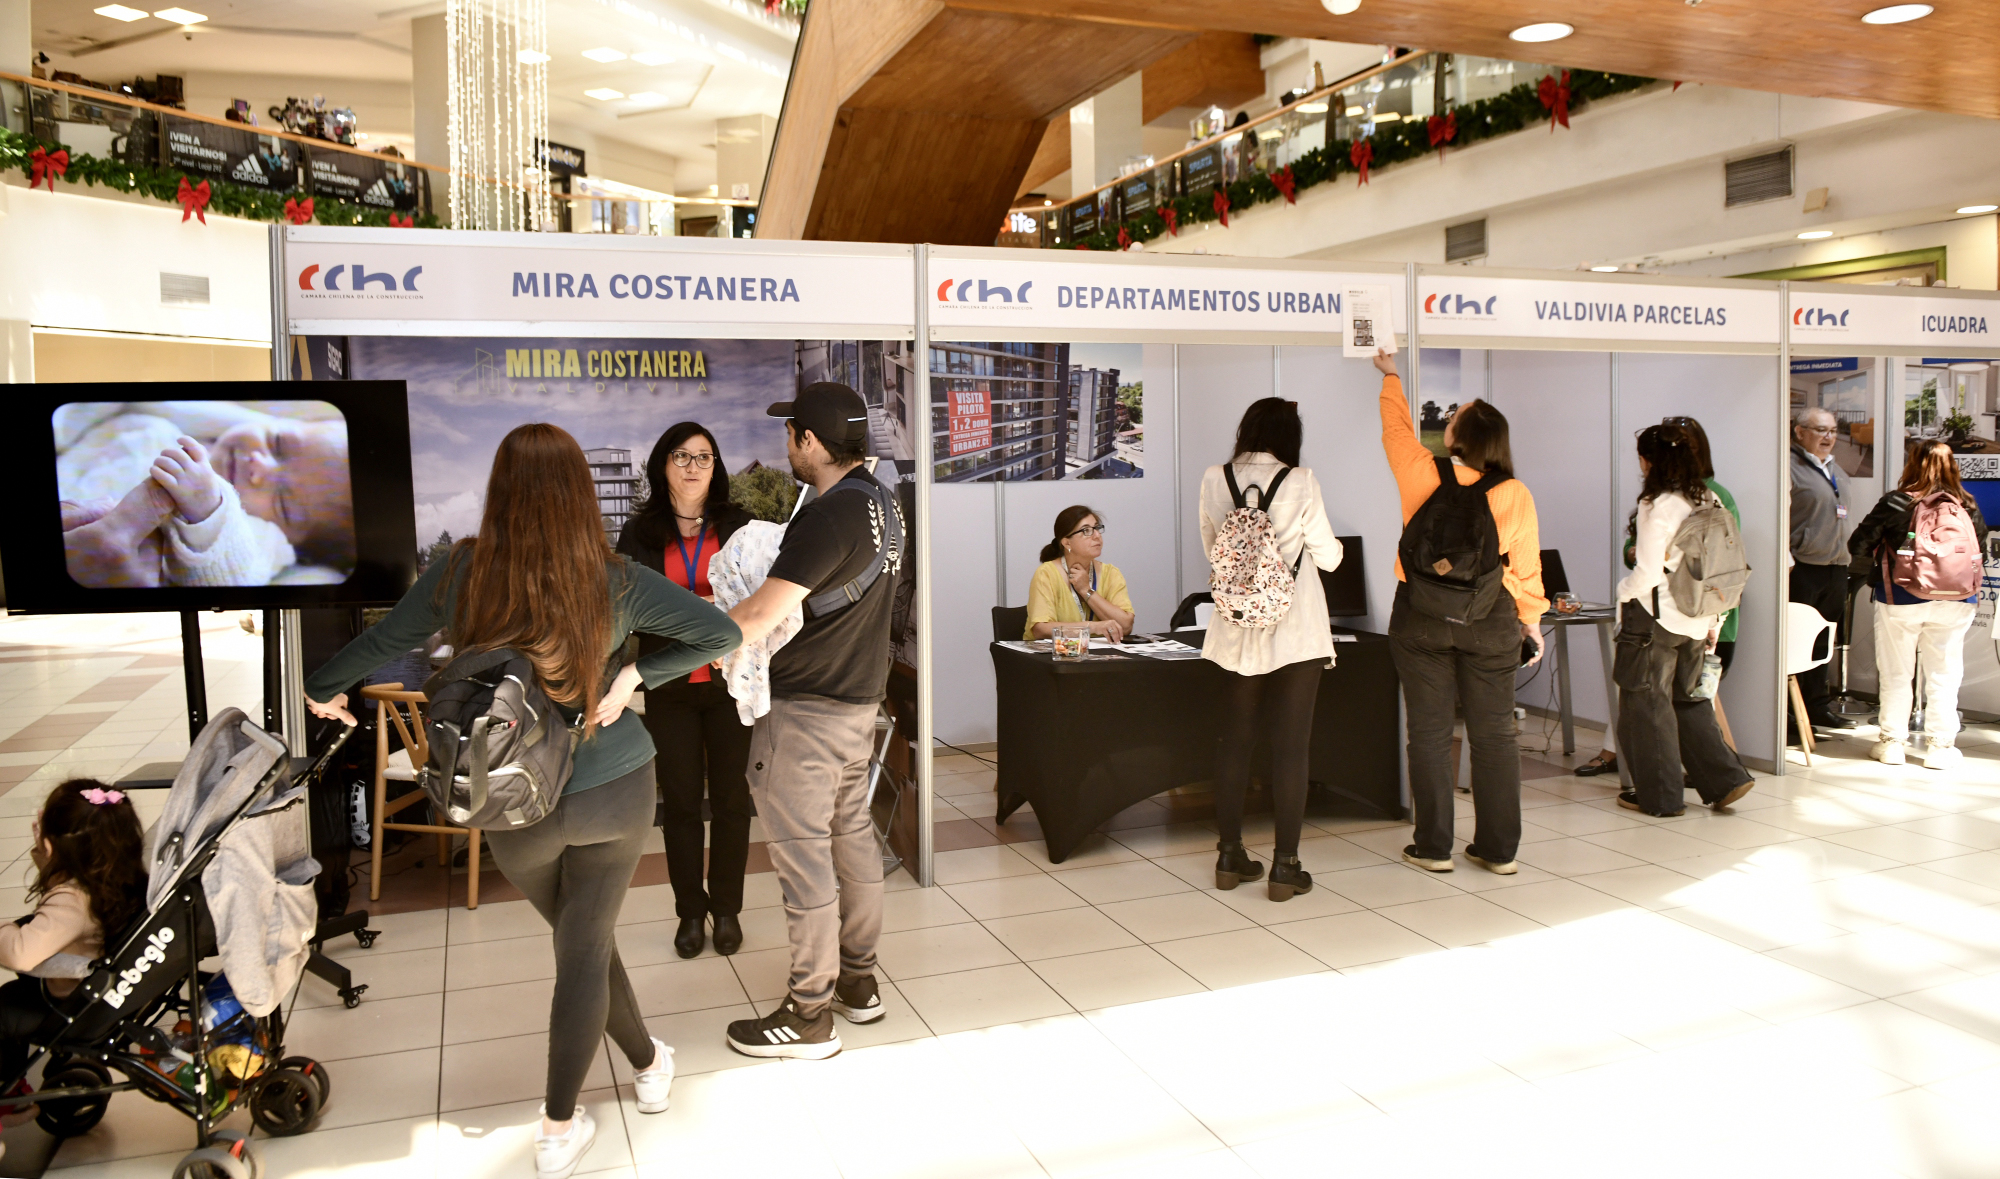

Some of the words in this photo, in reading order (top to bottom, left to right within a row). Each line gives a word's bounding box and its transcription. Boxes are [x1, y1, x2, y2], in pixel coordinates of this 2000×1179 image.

[193, 136, 200, 146] A
[232, 169, 268, 185] adidas
[512, 272, 599, 298] MIRA
[609, 274, 800, 302] COSTANERA
[1057, 285, 1260, 312] DEPARTAMENTOS
[1535, 300, 1627, 322] VALDIVIA
[1634, 304, 1726, 326] PARCELAS
[1922, 315, 1988, 333] ICUADRA
[506, 348, 581, 378] MIRA
[587, 350, 707, 378] COSTANERA
[508, 382, 708, 394] VALDIVIA
[956, 392, 984, 404] VISITA
[958, 404, 984, 415] PILOTO
[953, 419, 958, 431] 1
[964, 418, 970, 429] 2
[973, 419, 988, 428] DORM
[953, 437, 989, 452] URBAN2.CL
[103, 927, 175, 1009] Bebeglo
